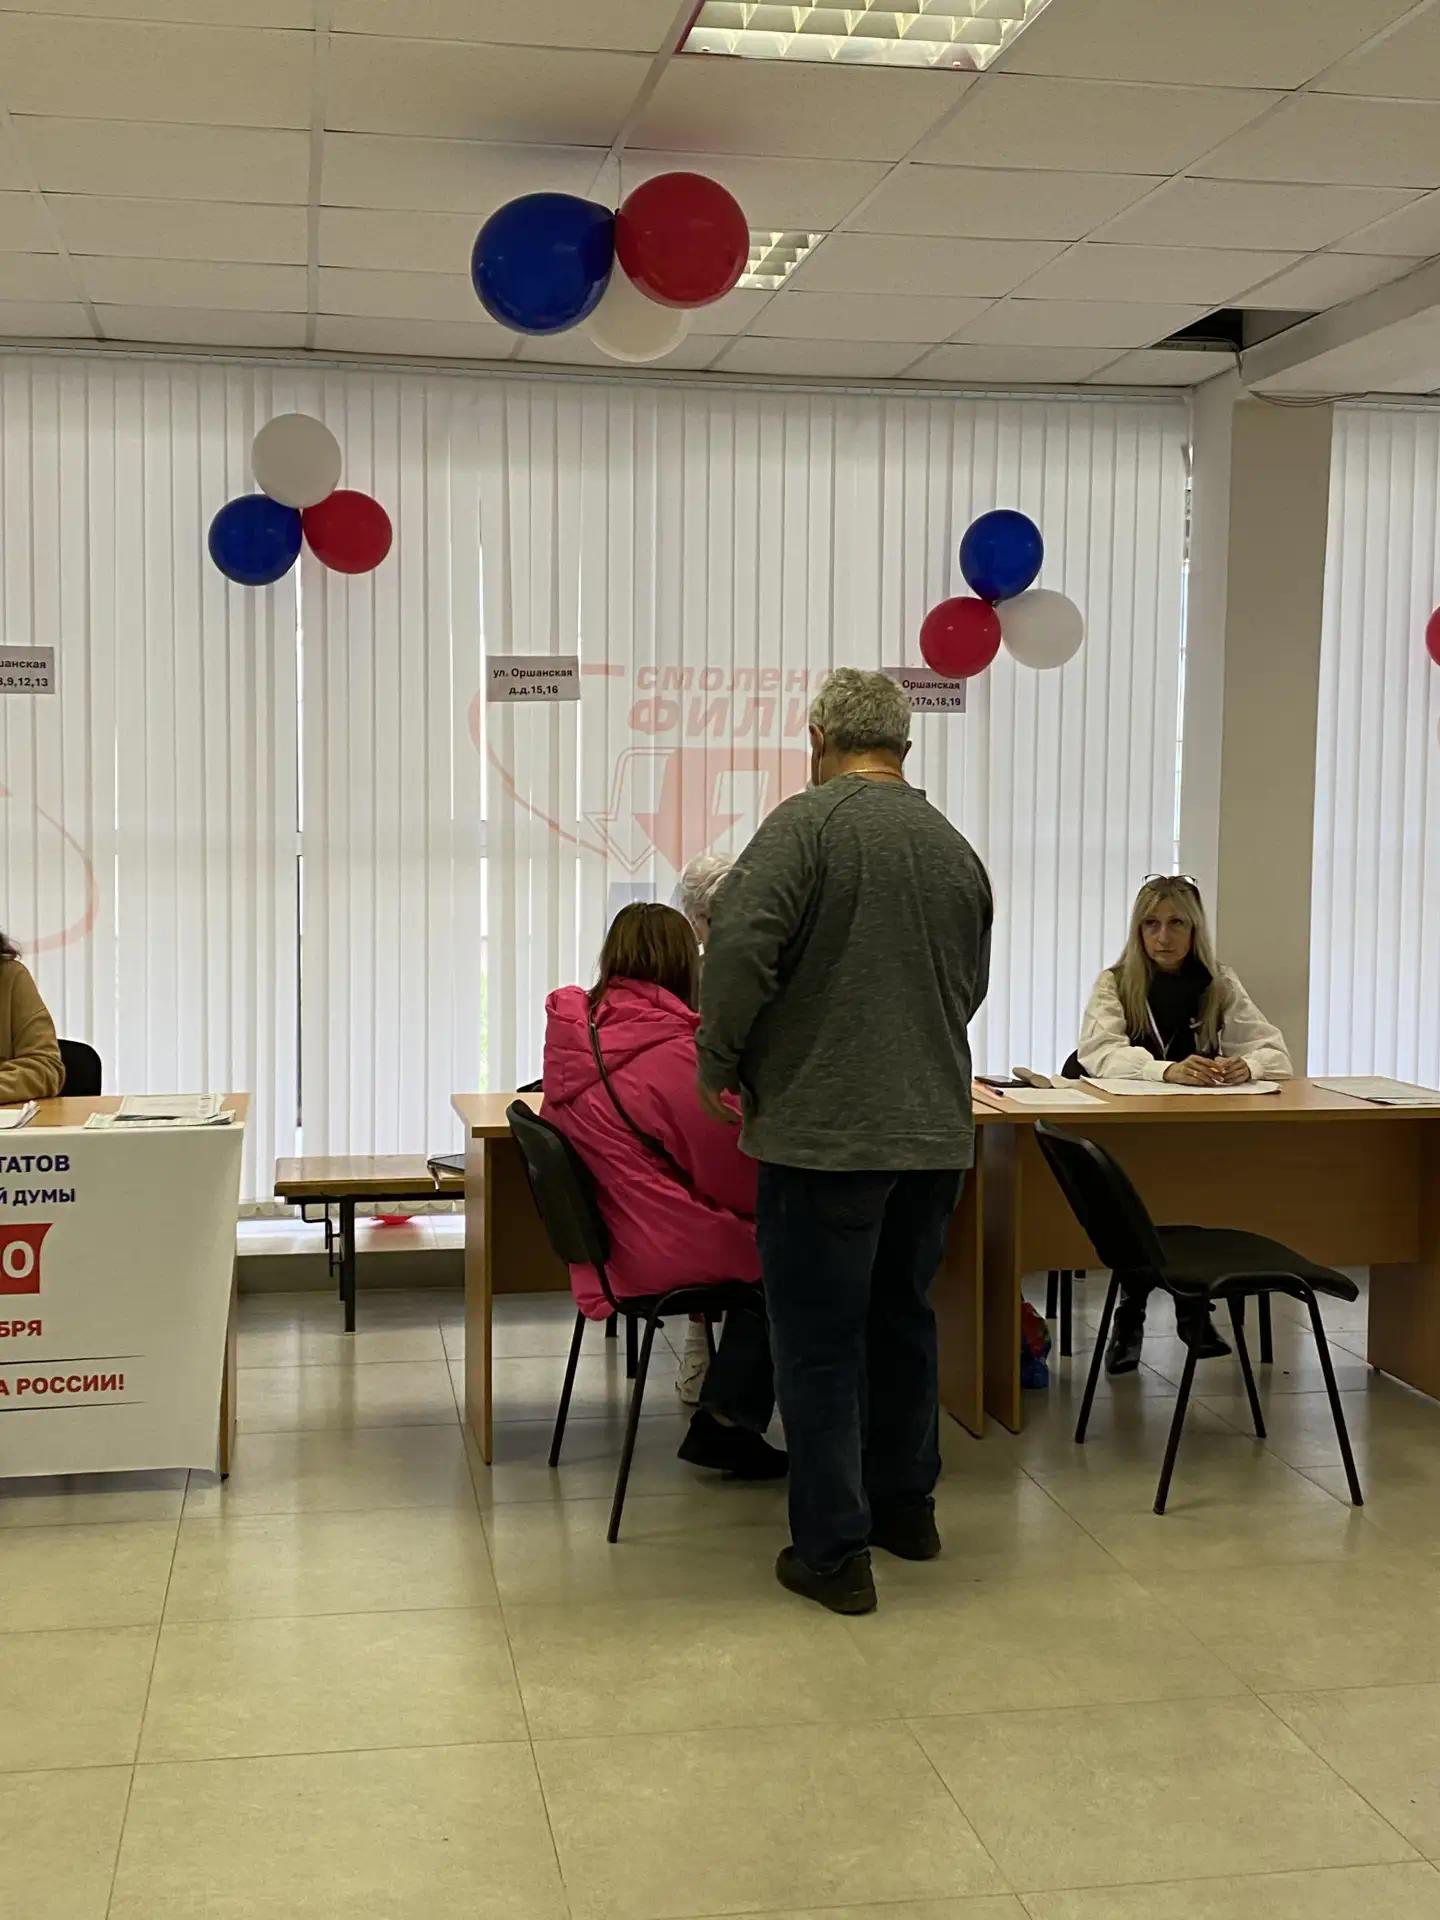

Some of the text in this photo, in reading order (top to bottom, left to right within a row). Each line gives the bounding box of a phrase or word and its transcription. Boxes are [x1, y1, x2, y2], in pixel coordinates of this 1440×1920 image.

[493, 668, 573, 679] ул. Оршанская
[509, 685, 559, 695] д.д.15,16
[902, 680, 960, 690] Оршанская
[13, 1188, 75, 1206] ДУМЫ
[17, 1374, 124, 1395] РОССИИ!
